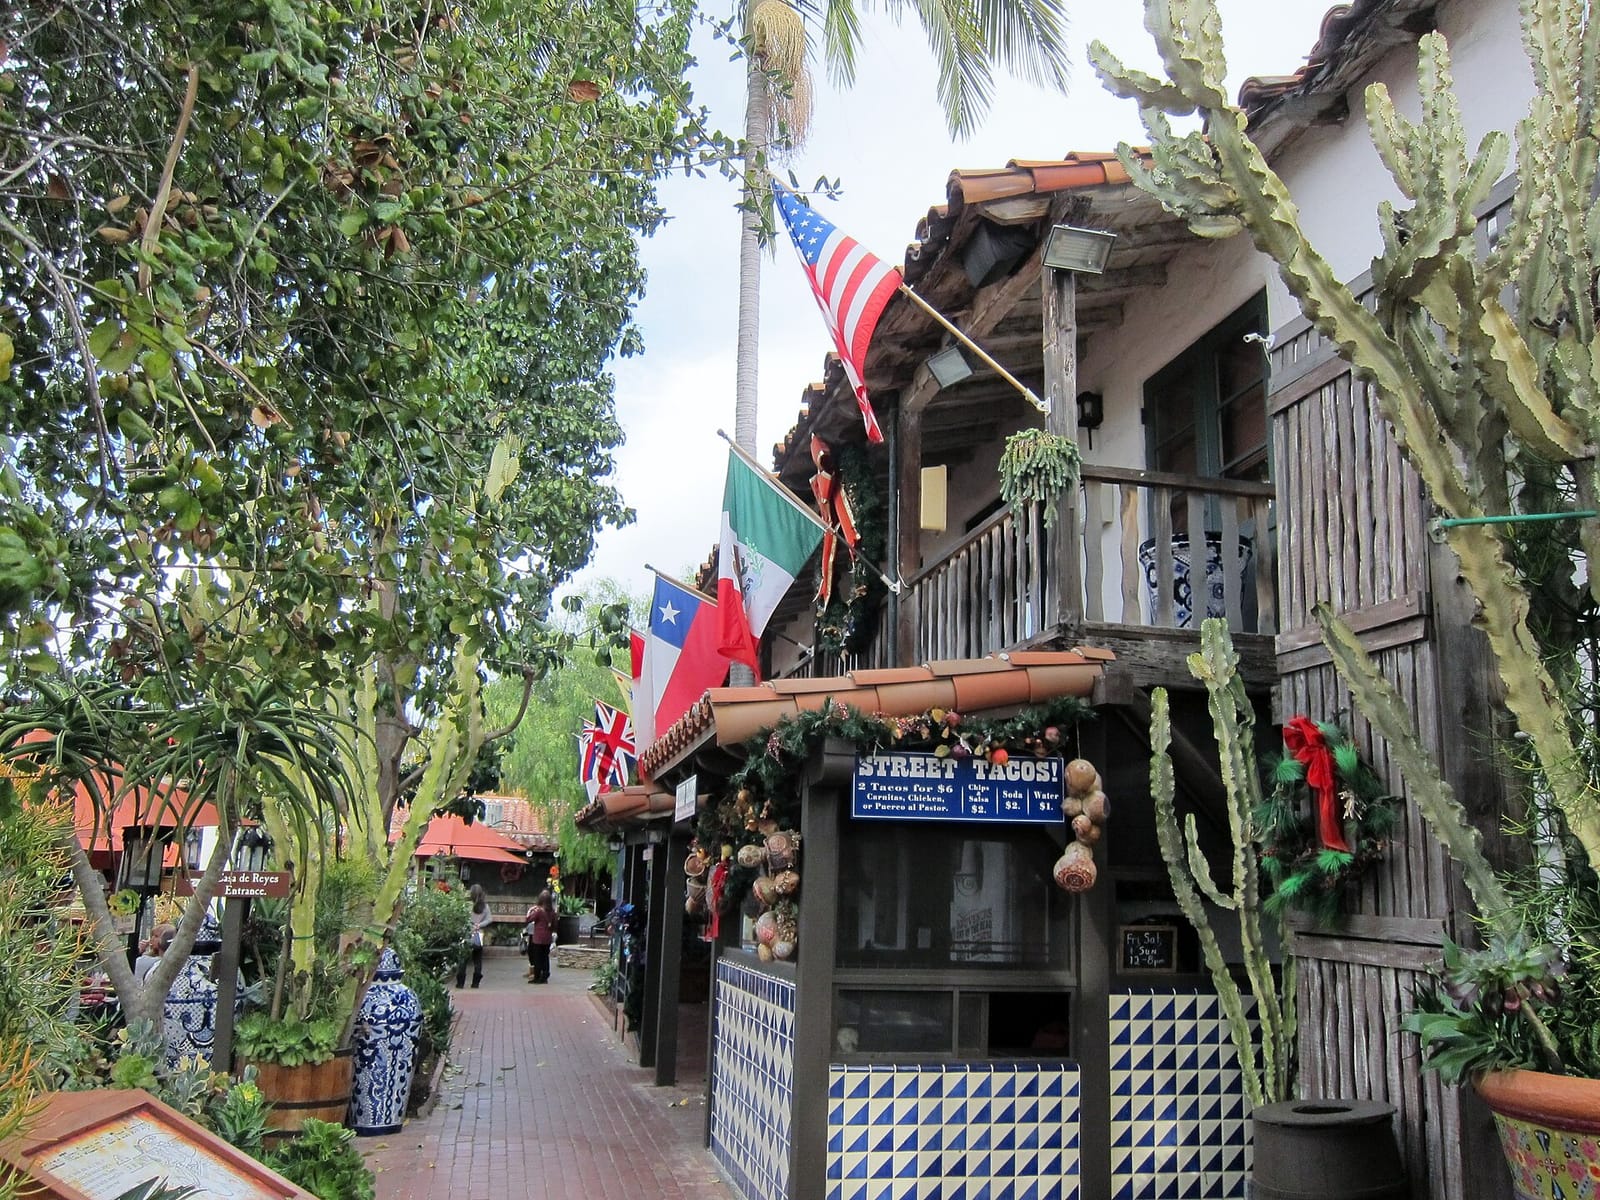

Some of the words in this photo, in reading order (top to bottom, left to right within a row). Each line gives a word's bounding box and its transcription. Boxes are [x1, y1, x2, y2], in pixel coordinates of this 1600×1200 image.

[858, 756, 958, 779] STREET
[972, 760, 1058, 782] TACOS!
[857, 782, 866, 791] 2
[870, 782, 909, 792] Tacos
[912, 783, 933, 793] for
[937, 783, 954, 794] $6
[968, 783, 990, 793] Chips
[866, 792, 906, 802] Carnitas,
[907, 794, 945, 803] Chicken,
[968, 795, 989, 803] Salsa
[1002, 790, 1024, 799] Soda
[1033, 790, 1060, 800] Water
[875, 802, 906, 811] Puerco
[907, 803, 916, 811] al
[918, 803, 949, 813] Pastor.
[971, 804, 987, 815] $2.
[1005, 800, 1021, 811] $2.
[1039, 801, 1054, 812] $1.
[239, 873, 250, 883] de
[252, 873, 279, 886] Reyes
[225, 885, 267, 896] Entrance.
